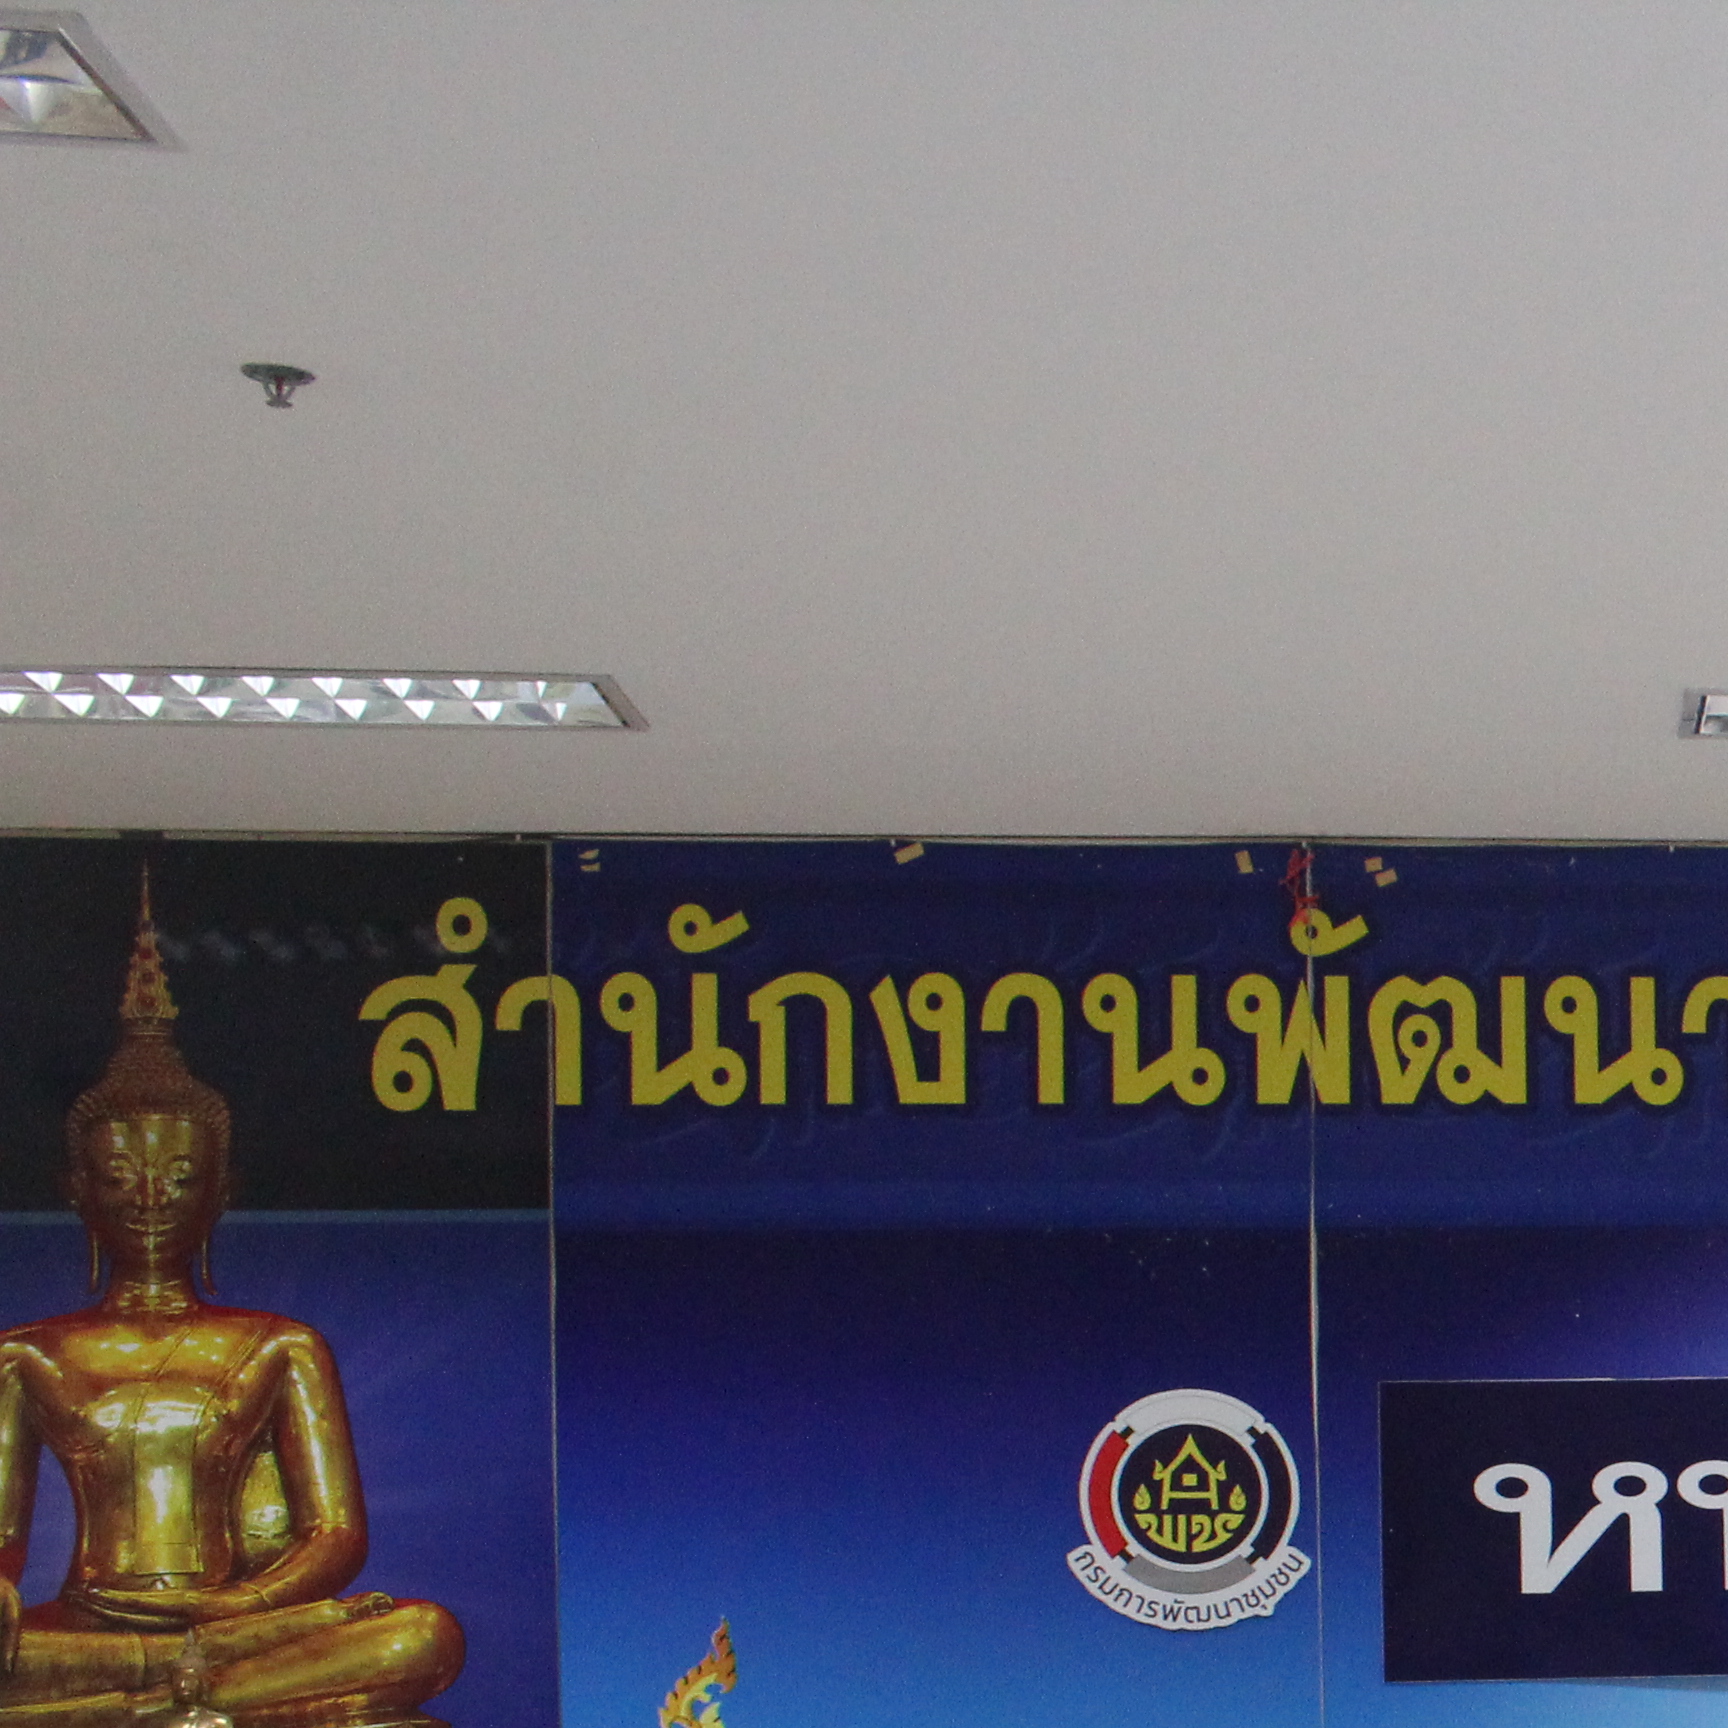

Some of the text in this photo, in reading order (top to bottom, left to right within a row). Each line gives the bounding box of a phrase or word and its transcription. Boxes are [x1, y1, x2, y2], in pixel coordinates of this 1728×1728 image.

[1074, 1551, 1305, 1622] กรมการพัฒนาชุมชน
